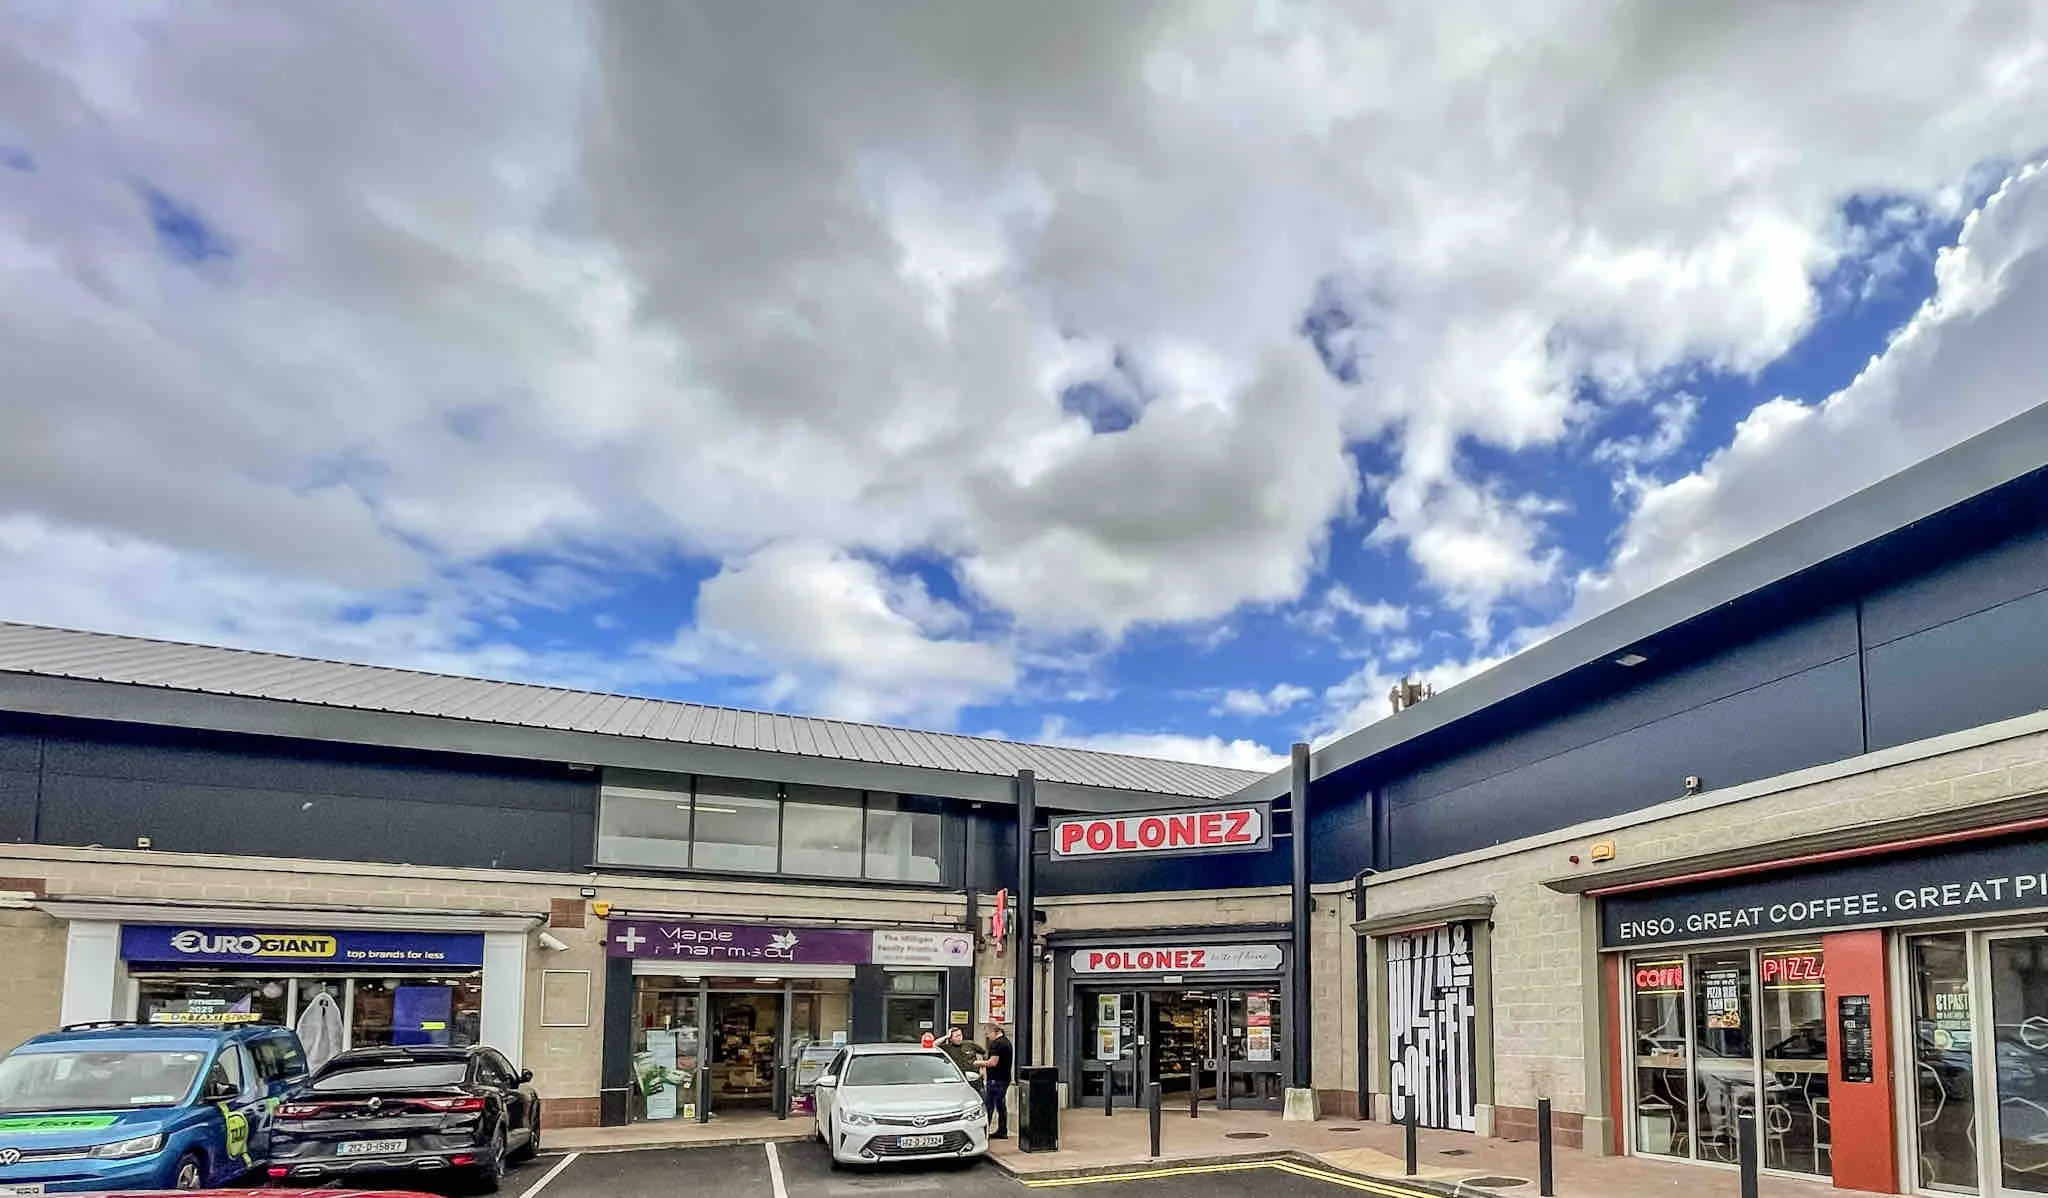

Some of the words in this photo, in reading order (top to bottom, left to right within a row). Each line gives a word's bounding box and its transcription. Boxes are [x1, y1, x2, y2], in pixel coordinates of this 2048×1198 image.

[1061, 811, 1251, 853] POLONEZ
[1686, 907, 1764, 933] GREAT
[1894, 877, 2008, 911] GREAT
[347, 950, 364, 959] top
[368, 950, 404, 959] brands
[407, 951, 422, 960] for
[425, 951, 445, 960] less
[1089, 950, 1206, 970] POLONEZ
